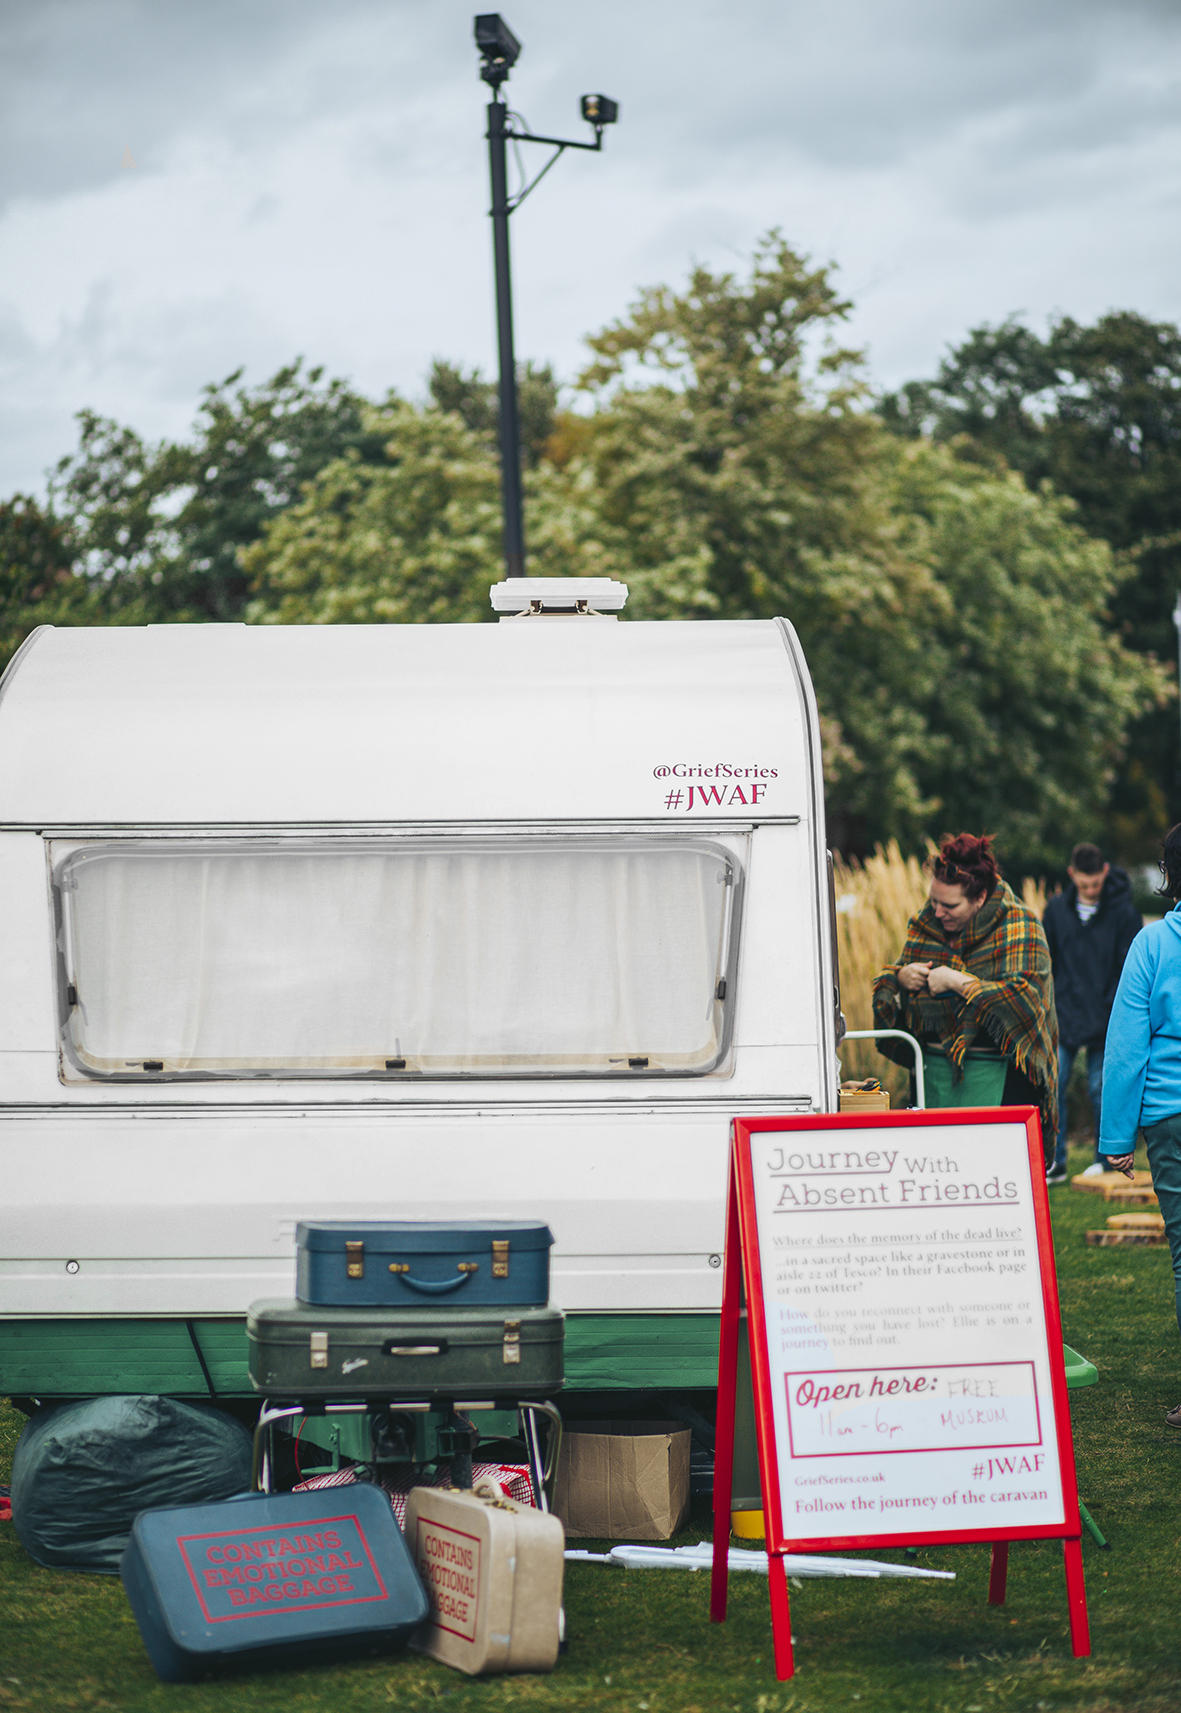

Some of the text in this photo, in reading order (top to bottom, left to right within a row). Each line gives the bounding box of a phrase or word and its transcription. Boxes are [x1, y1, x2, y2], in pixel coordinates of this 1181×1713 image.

[653, 763, 778, 780] @GriefSeries
[664, 783, 767, 811] #JWAF
[767, 1148, 959, 1174] Journey With
[777, 1177, 1018, 1206] Absent Friends
[772, 1226, 1022, 1246] Where does the memory of the dead live?
[802, 1257, 808, 1265] a
[812, 1252, 851, 1265] sacred
[854, 1254, 887, 1266] space
[891, 1250, 913, 1262] like
[917, 1253, 923, 1261] a
[926, 1250, 993, 1263] gravestone
[996, 1250, 1009, 1258] or
[1013, 1246, 1025, 1257] in
[776, 1262, 1027, 1281] aisle 22 of Tesco? In their Facebook page
[777, 1281, 863, 1295] or on twitter?
[779, 1302, 1030, 1321] How do you reconnect with someone or
[780, 1322, 847, 1335] something
[853, 1322, 876, 1333] you
[883, 1319, 911, 1330] have
[918, 1316, 945, 1328] lost?
[986, 1316, 996, 1326] is
[1003, 1316, 1019, 1325] on
[1026, 1316, 1032, 1324] a
[781, 1338, 828, 1352] journey
[833, 1337, 846, 1346] to
[849, 1334, 873, 1346] find
[796, 1376, 938, 1408] Open here:
[948, 1378, 1000, 1399] FREE
[795, 1472, 885, 1487] GriefSeries.co.uk
[972, 1453, 1045, 1481] #JWAF
[795, 1489, 1048, 1513] Follow the journey of the caravan
[205, 1530, 342, 1565] CONTAINS
[424, 1535, 473, 1571] CONTAINS
[202, 1551, 364, 1588] EMOTIONAL
[420, 1559, 475, 1599] EMOTIONAL
[226, 1574, 355, 1608] BAGGAGE
[426, 1585, 469, 1622] AGGAGE
